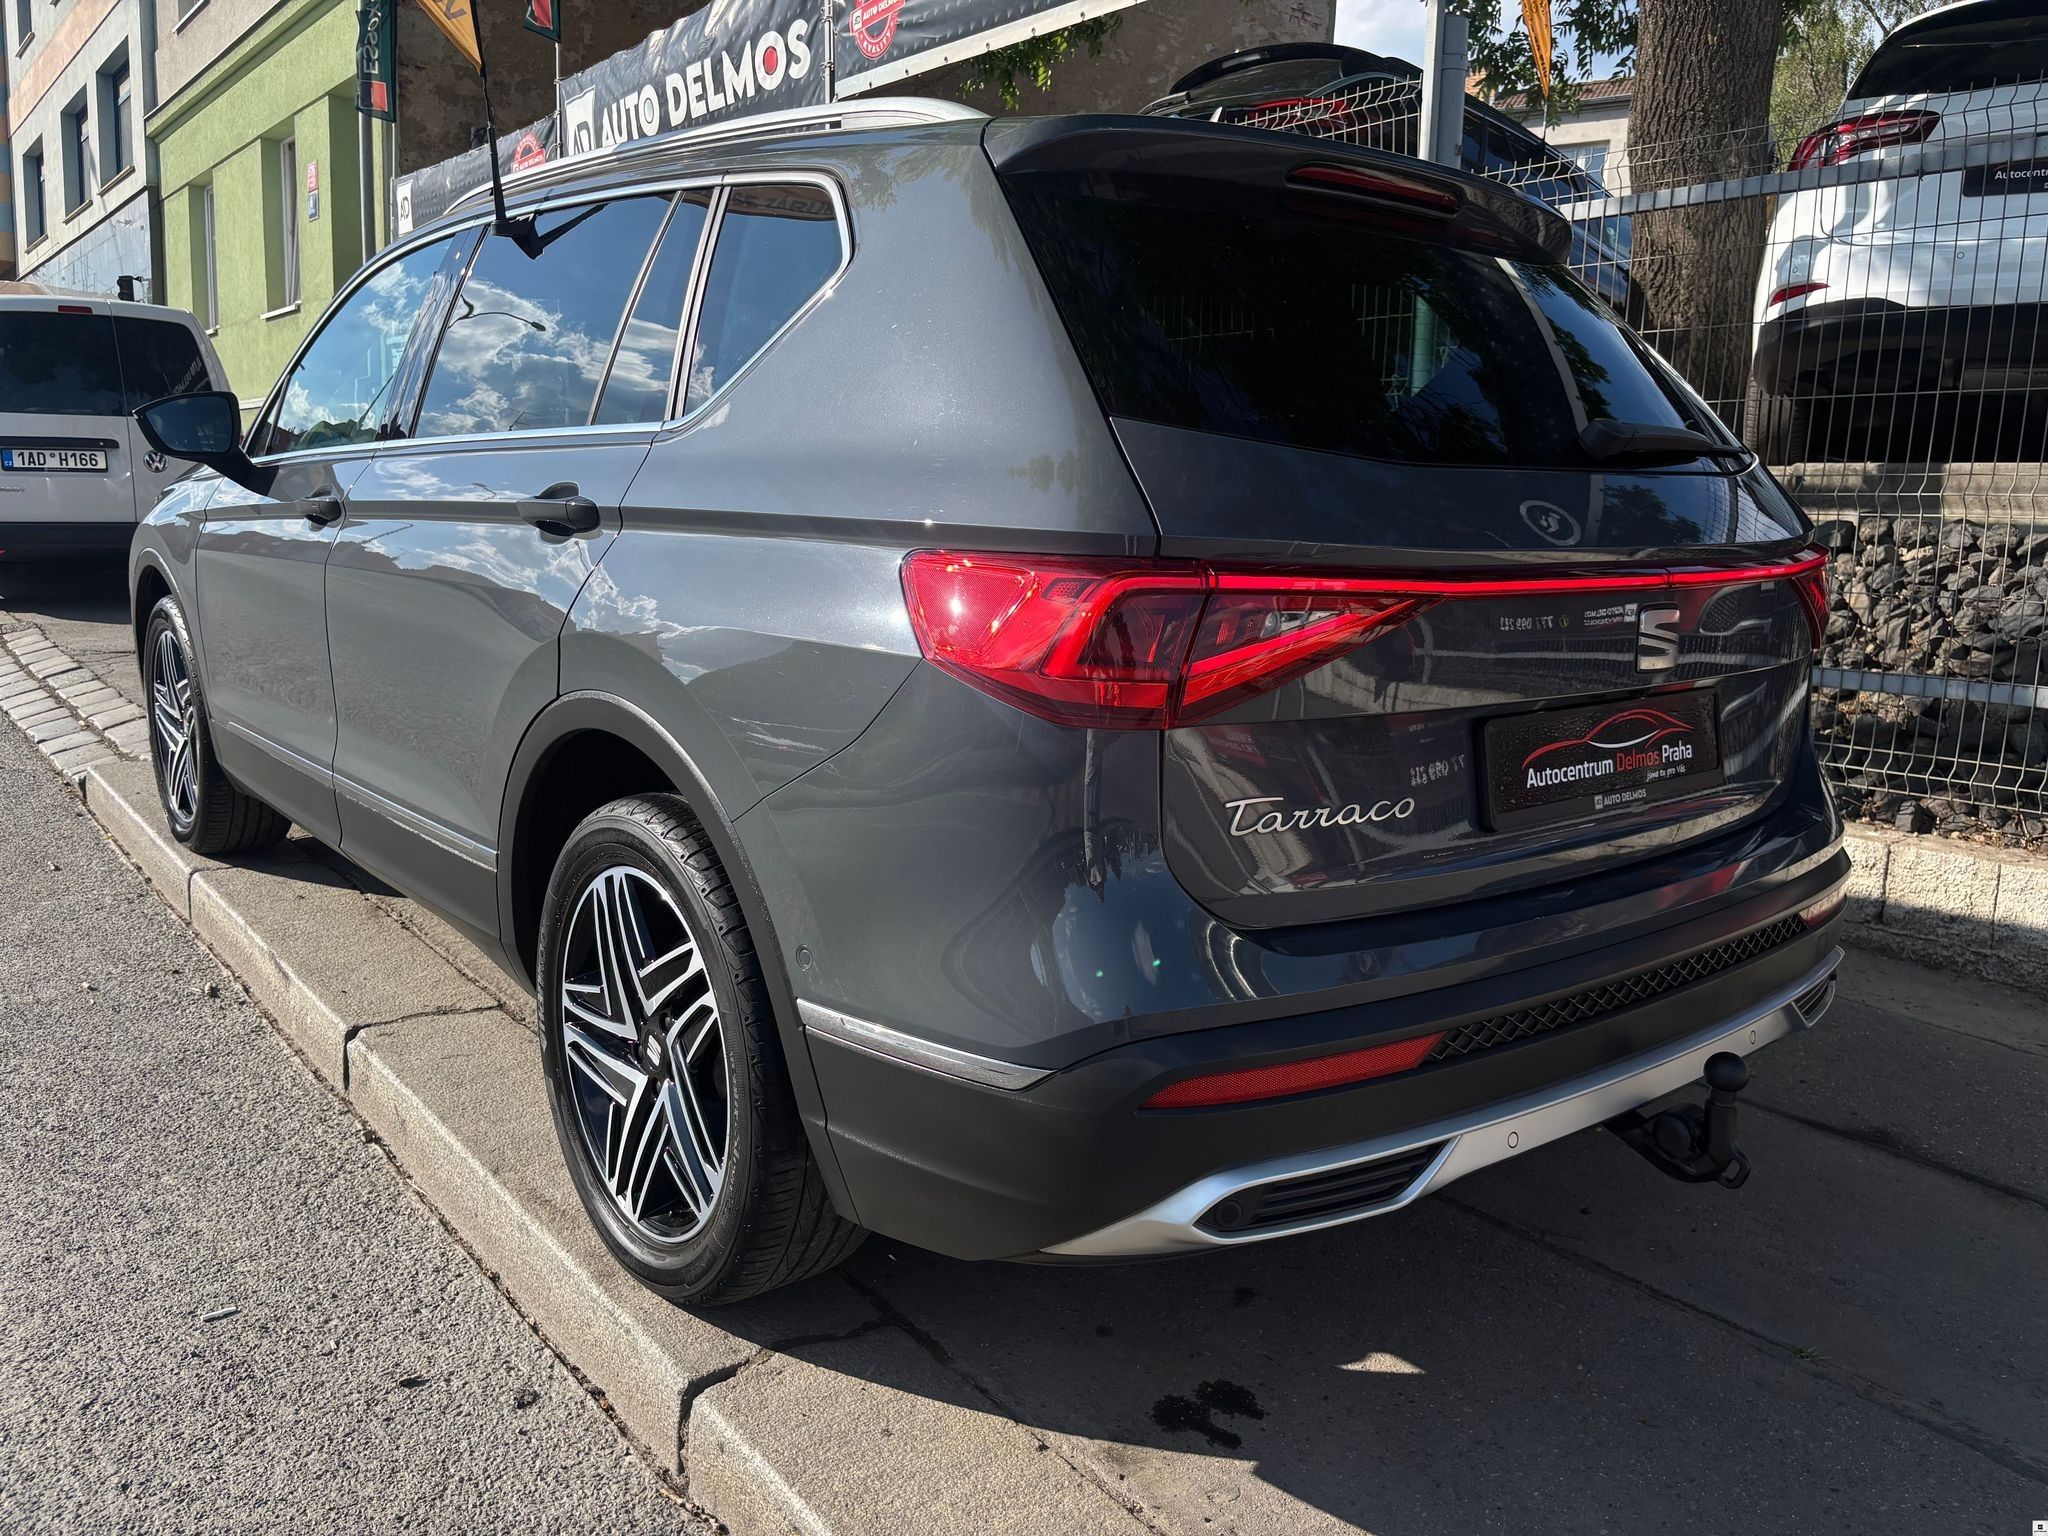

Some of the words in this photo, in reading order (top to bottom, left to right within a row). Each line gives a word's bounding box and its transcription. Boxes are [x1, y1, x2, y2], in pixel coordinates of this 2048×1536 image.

[602, 84, 660, 148] AUTO
[665, 19, 811, 127] DELMOS
[17, 451, 47, 467] 1AD
[59, 452, 98, 467] H166
[1526, 758, 1614, 789] Autocentrum
[1616, 749, 1660, 772] Delmos
[1662, 740, 1692, 763] Praha
[1225, 796, 1415, 837] Tarraco
[1603, 793, 1621, 806] AUTO
[1621, 788, 1647, 802] DELMOS
